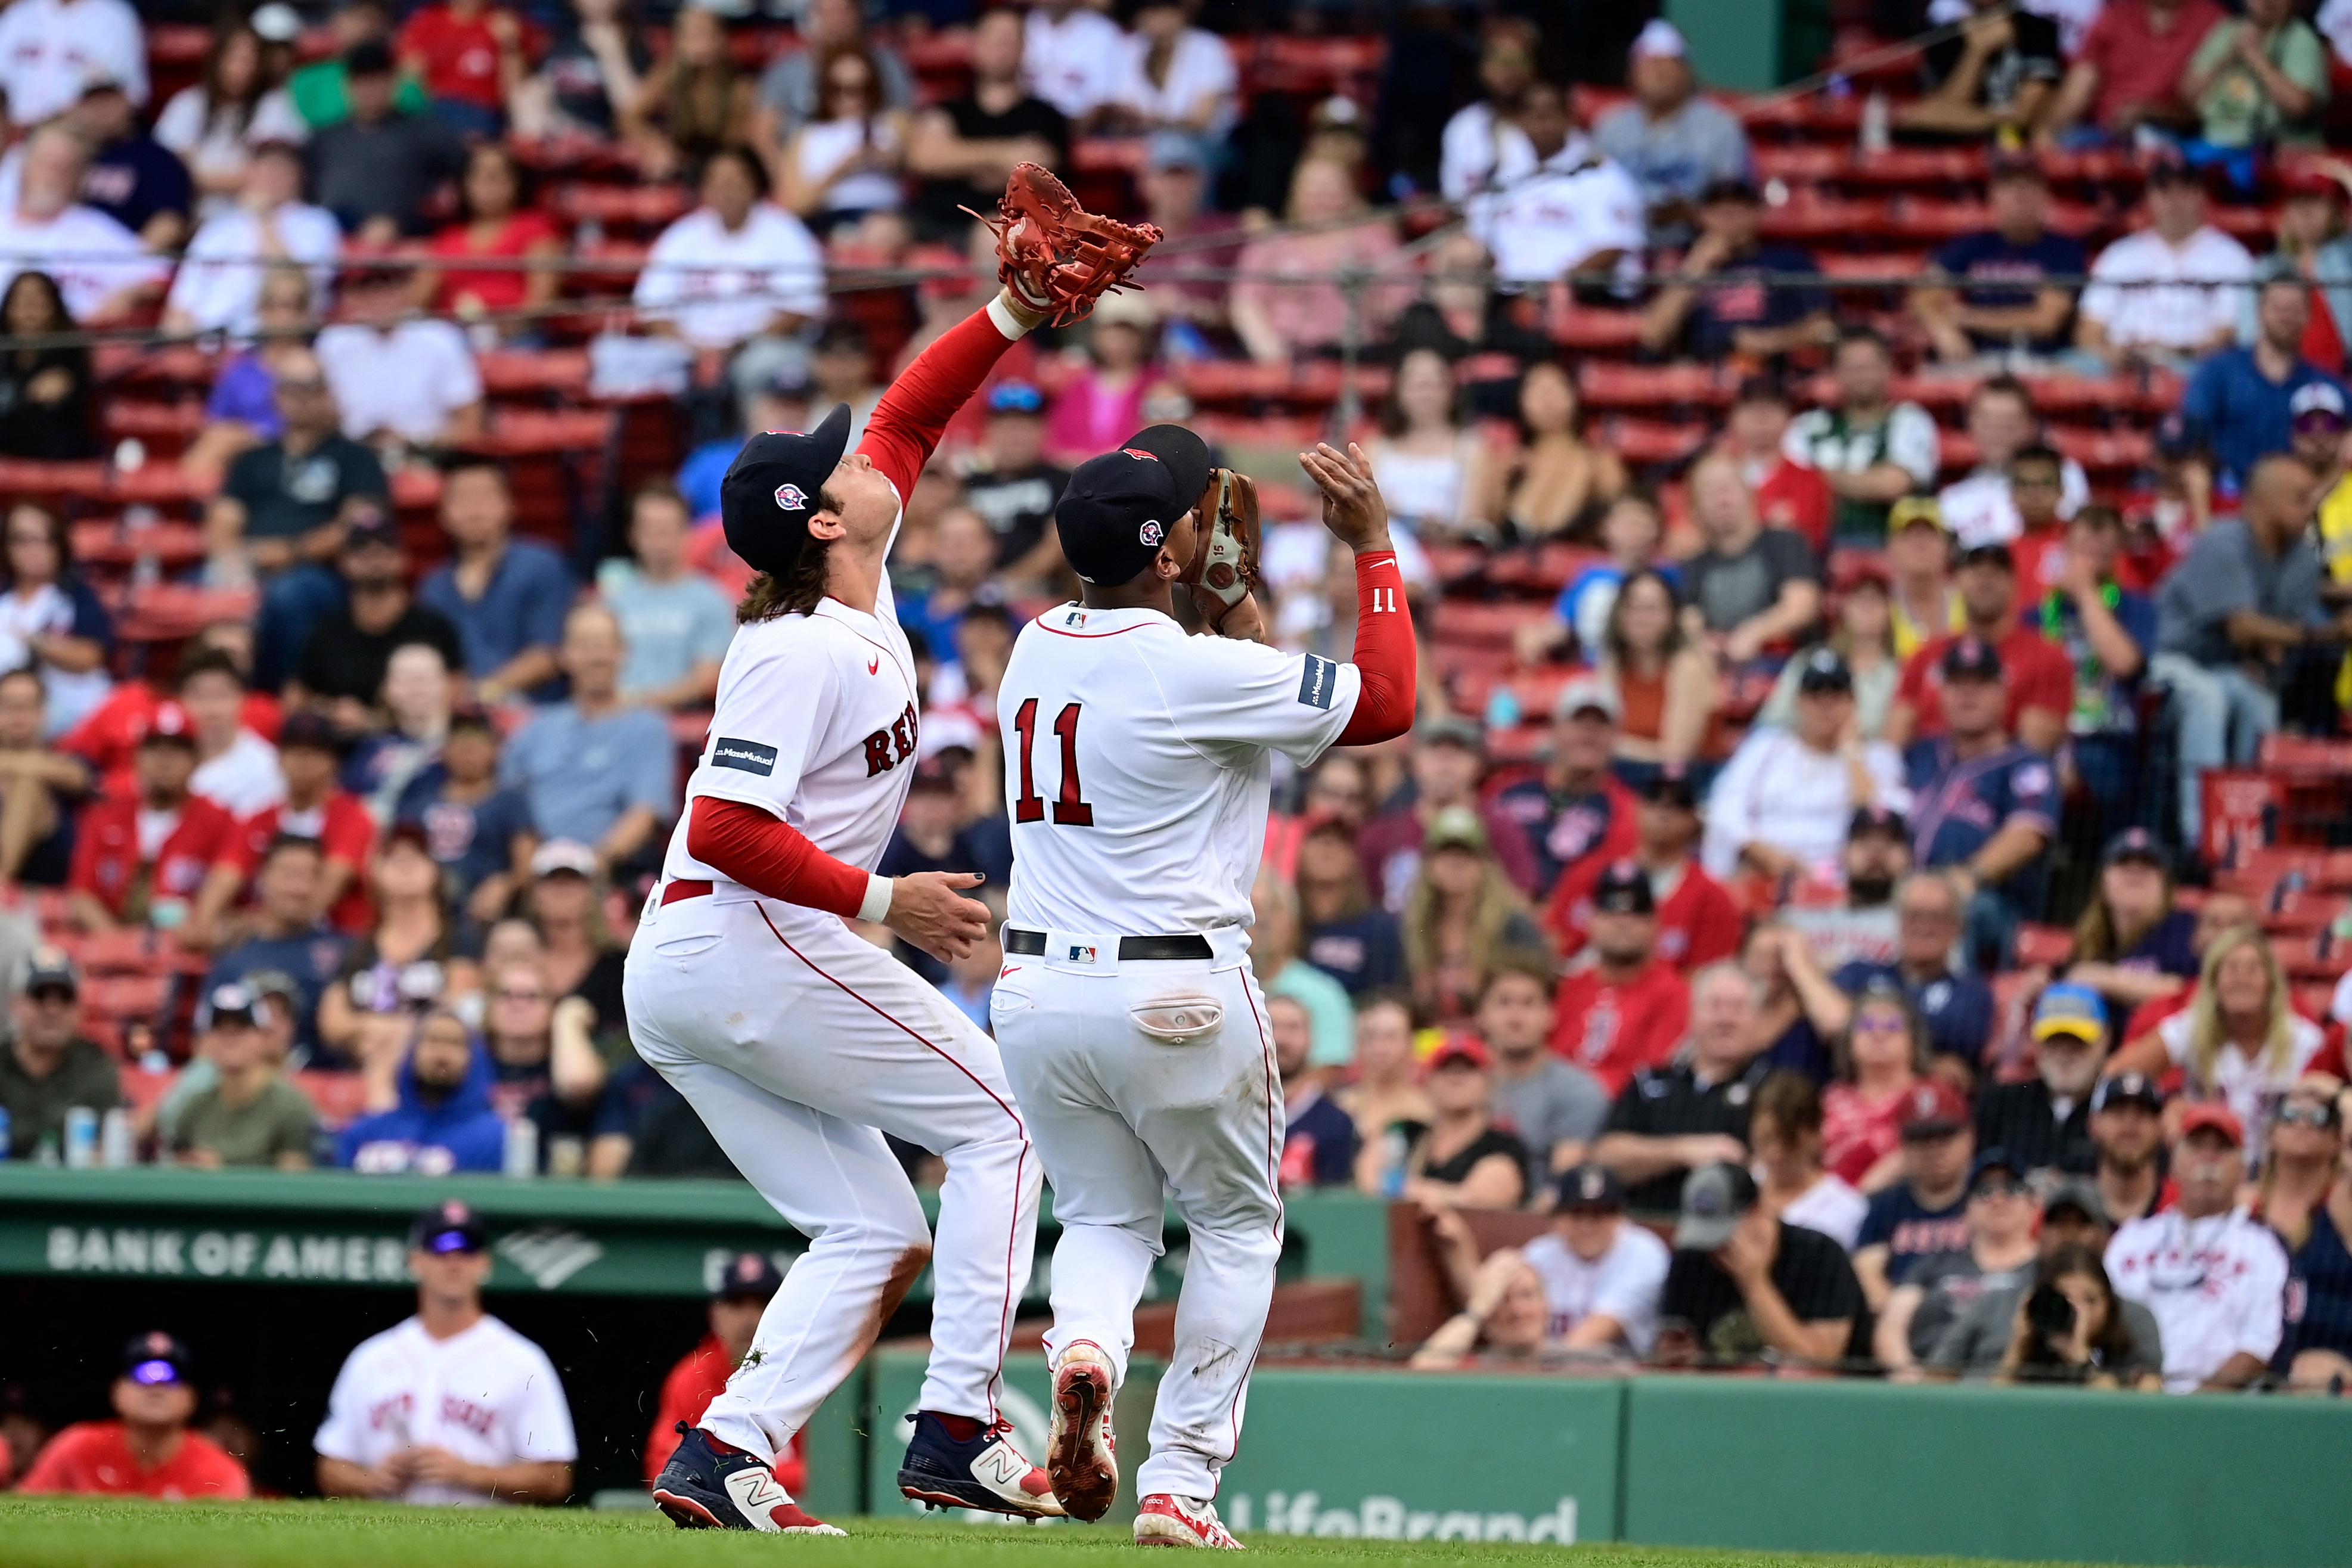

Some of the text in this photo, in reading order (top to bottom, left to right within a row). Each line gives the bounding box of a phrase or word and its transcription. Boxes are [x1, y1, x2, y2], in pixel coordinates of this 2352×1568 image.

[1213, 545, 1224, 556] 15
[1373, 588, 1397, 613] 11
[724, 747, 774, 766] MassMutual
[1014, 697, 1094, 827] 11
[47, 1226, 420, 1282] BANK OF AMER
